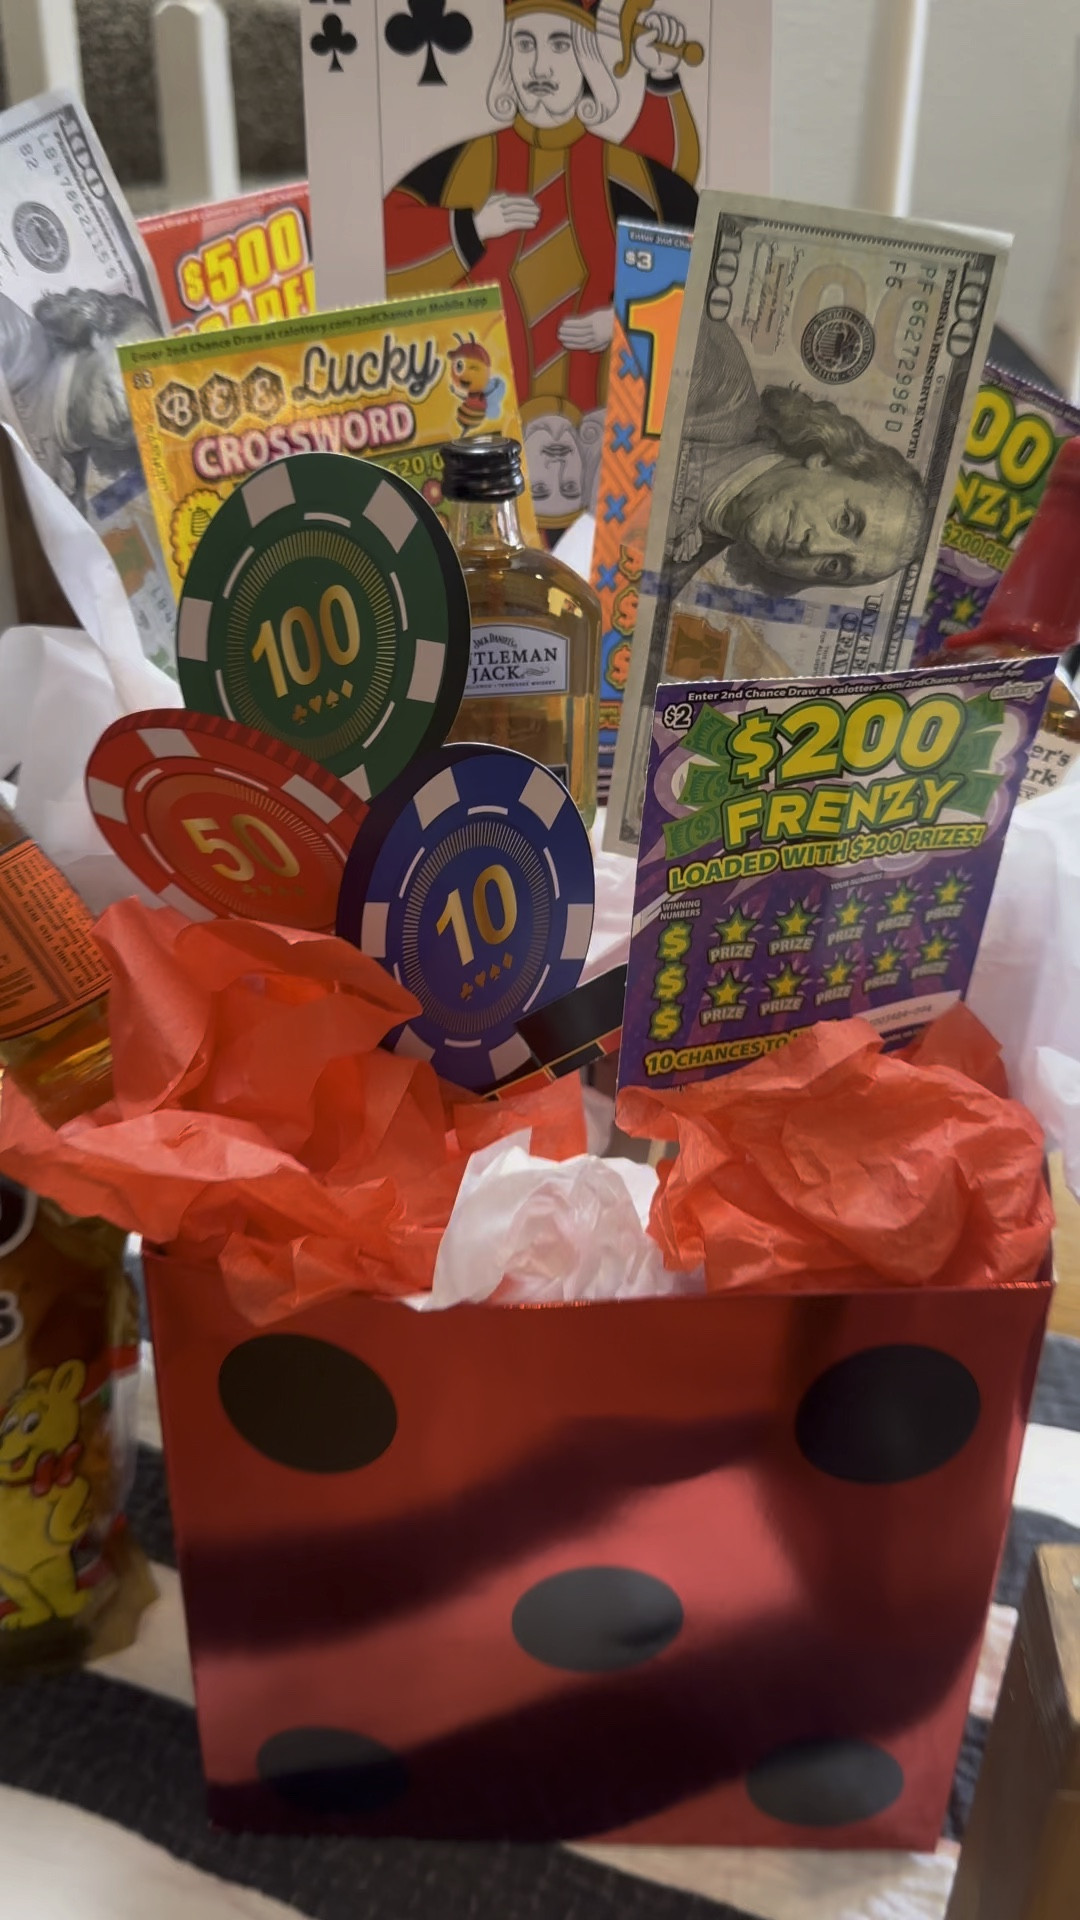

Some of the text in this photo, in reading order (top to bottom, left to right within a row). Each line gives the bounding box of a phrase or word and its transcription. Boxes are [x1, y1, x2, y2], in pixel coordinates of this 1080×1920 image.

[60, 117, 106, 199] 100
[180, 208, 304, 306] $500
[706, 230, 743, 322] 100
[885, 260, 906, 288] F6
[946, 260, 986, 359] 100
[291, 333, 442, 399] Lucky
[194, 402, 416, 479] CROSSWORD
[251, 584, 361, 699] 100
[469, 648, 558, 666] TLEMAN
[472, 665, 520, 684] JACK
[664, 704, 692, 728] $2
[688, 668, 1024, 702] Enter 2nd Chance Draw at calottery.com/2ndChance or Mobile App
[730, 696, 964, 784] $200
[1030, 745, 1071, 767] er's
[724, 776, 963, 848] FRENZY
[181, 814, 300, 882] 50
[670, 825, 986, 891] LOADED WITH $200 PRIZES!
[436, 864, 518, 966] 10
[660, 909, 700, 920] NUMBERS
[662, 899, 700, 911] WINNING
[710, 943, 756, 963] PRIZE
[770, 936, 815, 955] PRIZE
[702, 1006, 746, 1026] PRIZE
[760, 996, 803, 1016] PRIZE
[815, 985, 852, 1006] PRIZE
[649, 1053, 674, 1072] 10
[677, 1040, 761, 1067] CHANCES
